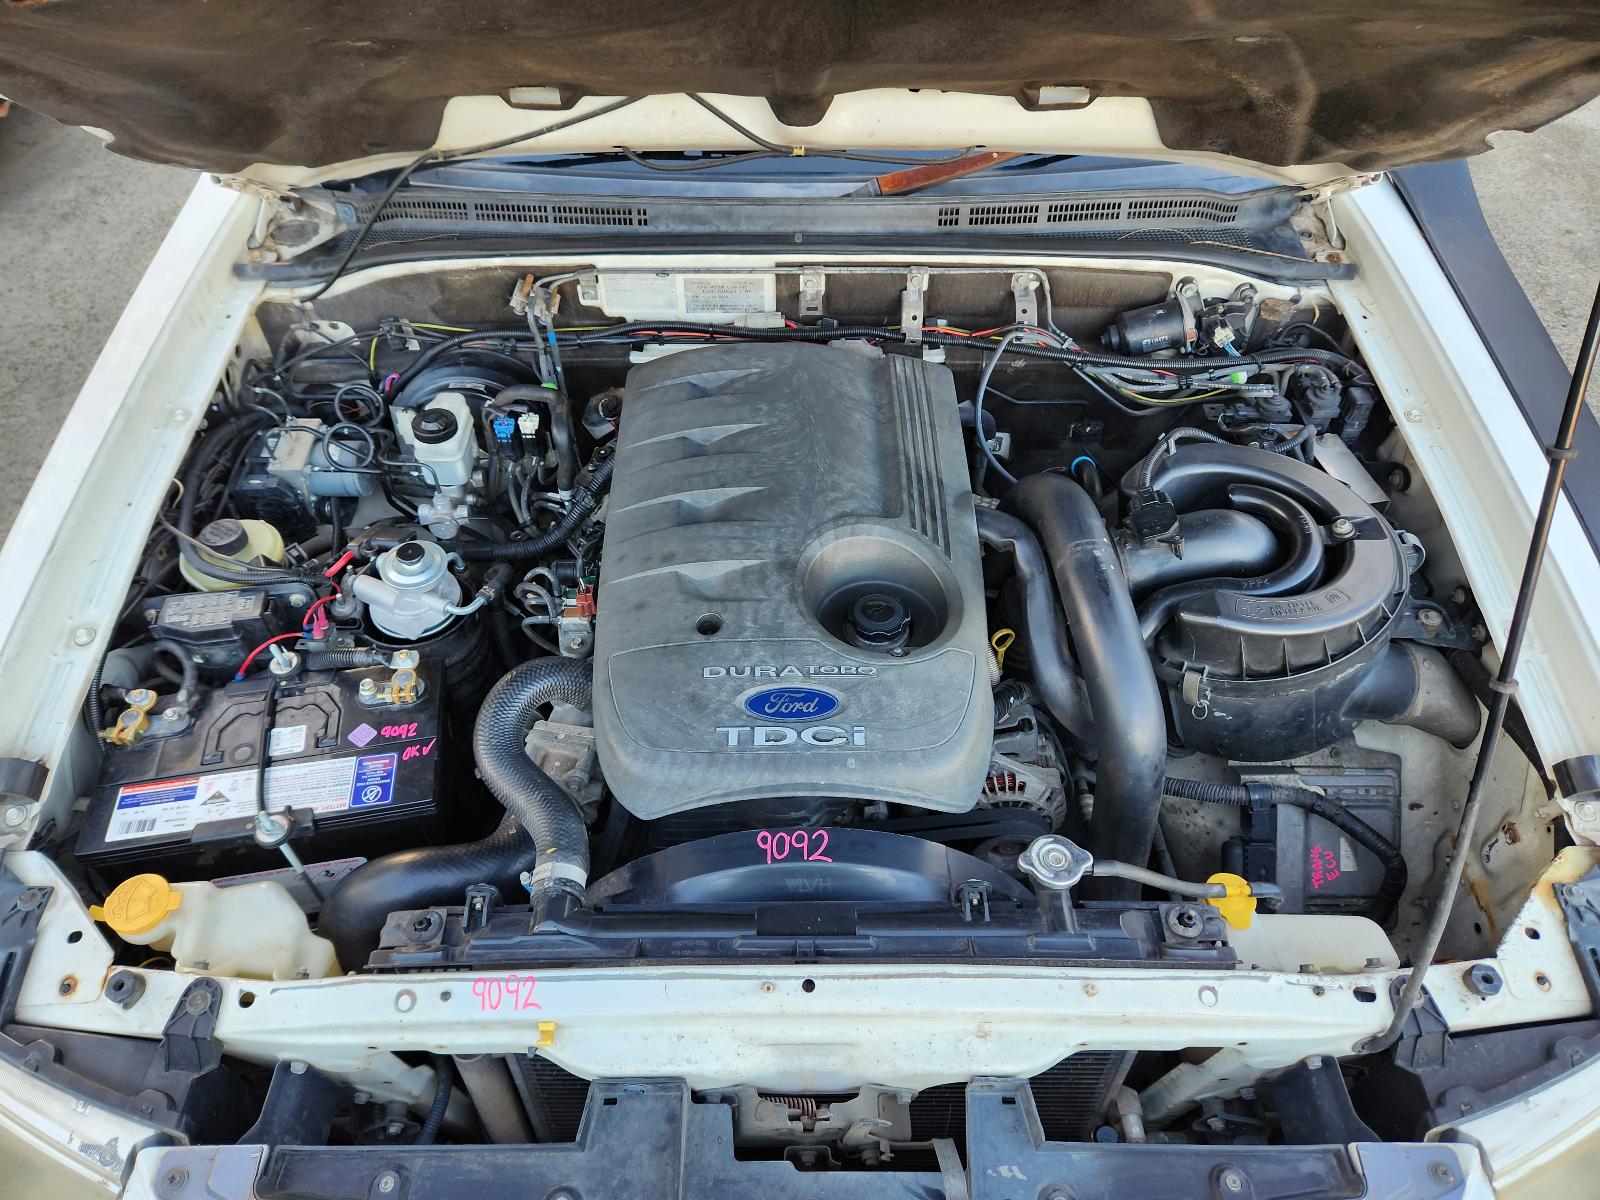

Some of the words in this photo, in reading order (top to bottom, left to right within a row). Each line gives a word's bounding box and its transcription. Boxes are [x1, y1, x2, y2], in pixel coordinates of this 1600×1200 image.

[703, 665, 877, 679] DURATORQ
[764, 692, 819, 714] Ford
[380, 722, 419, 739] 9092
[715, 725, 866, 747] TDCi
[756, 829, 833, 864] 9092
[471, 974, 542, 1011] 9092
